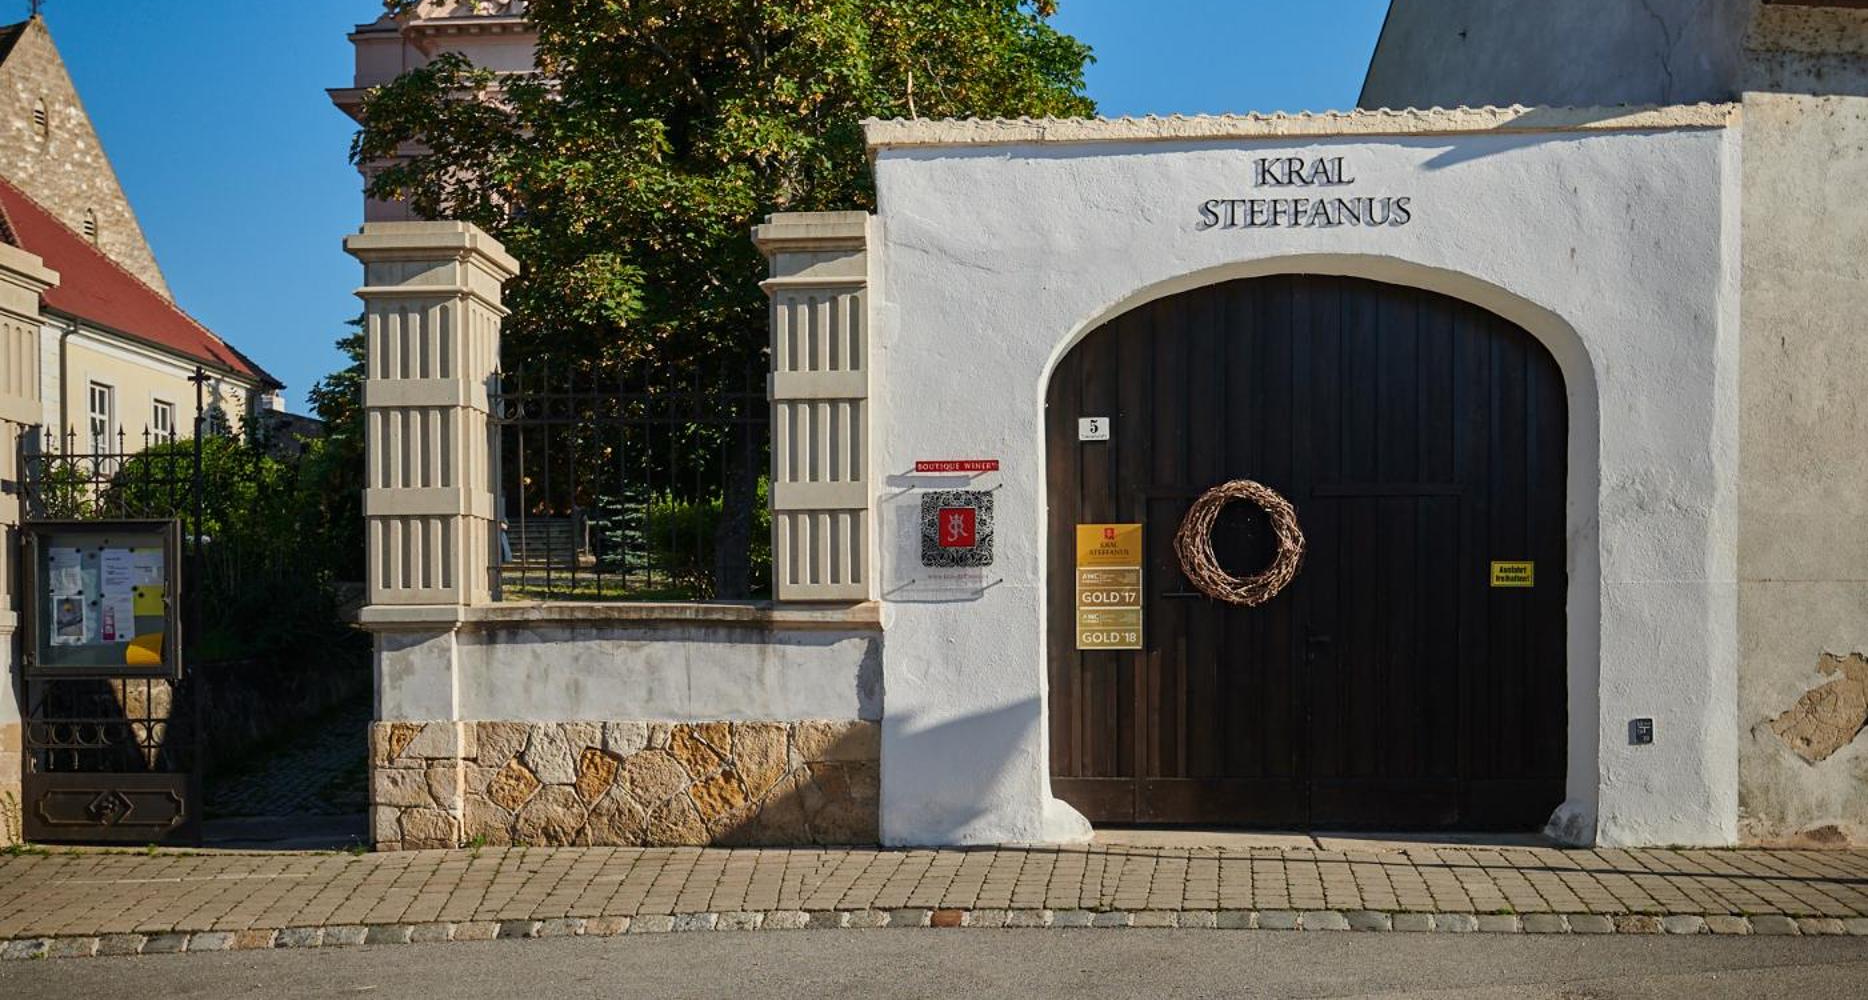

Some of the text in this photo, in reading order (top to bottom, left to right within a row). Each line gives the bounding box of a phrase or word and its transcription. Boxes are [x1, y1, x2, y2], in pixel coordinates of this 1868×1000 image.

[1257, 156, 1355, 185] KRAL
[1200, 196, 1412, 228] STEFFANUS
[1090, 419, 1098, 433] 5
[917, 461, 997, 471] BOUTIQUE WINERY
[1082, 591, 1120, 603] GOLD
[1082, 632, 1120, 643] GOLD
